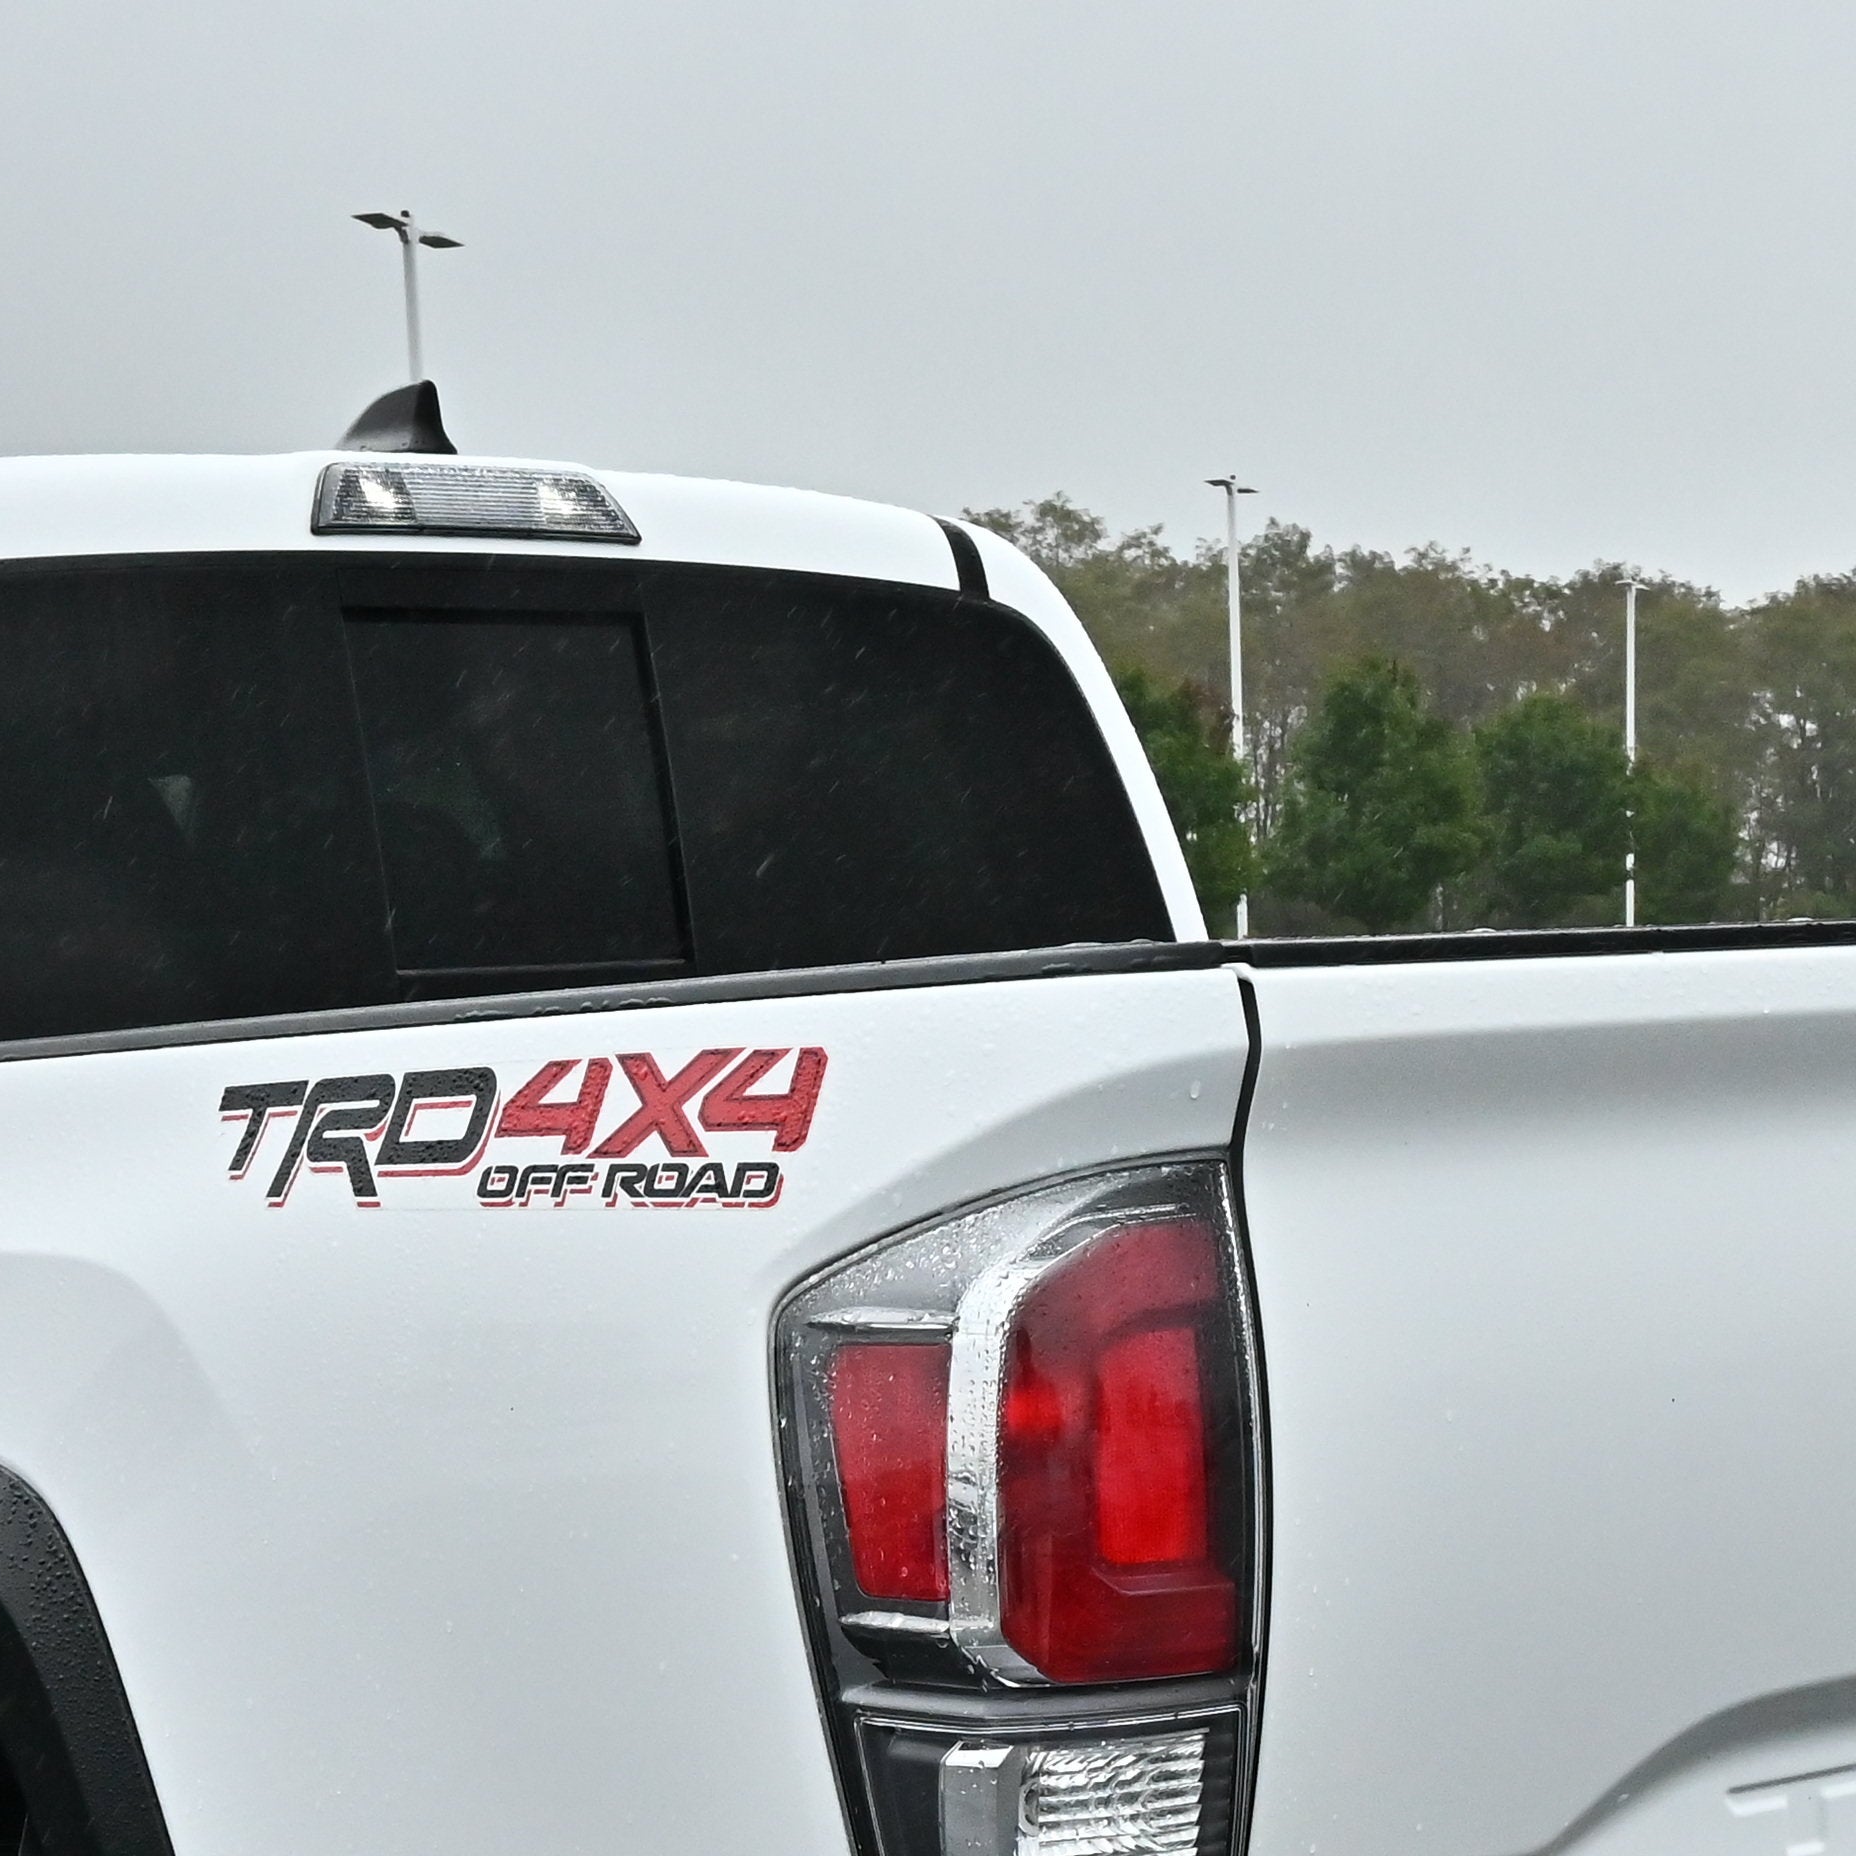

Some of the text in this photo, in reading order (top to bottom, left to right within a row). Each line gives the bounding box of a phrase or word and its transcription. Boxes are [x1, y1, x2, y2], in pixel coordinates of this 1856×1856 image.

[218, 1046, 829, 1207] TRD 4X4
[477, 1161, 785, 1208] OFF ROAD
